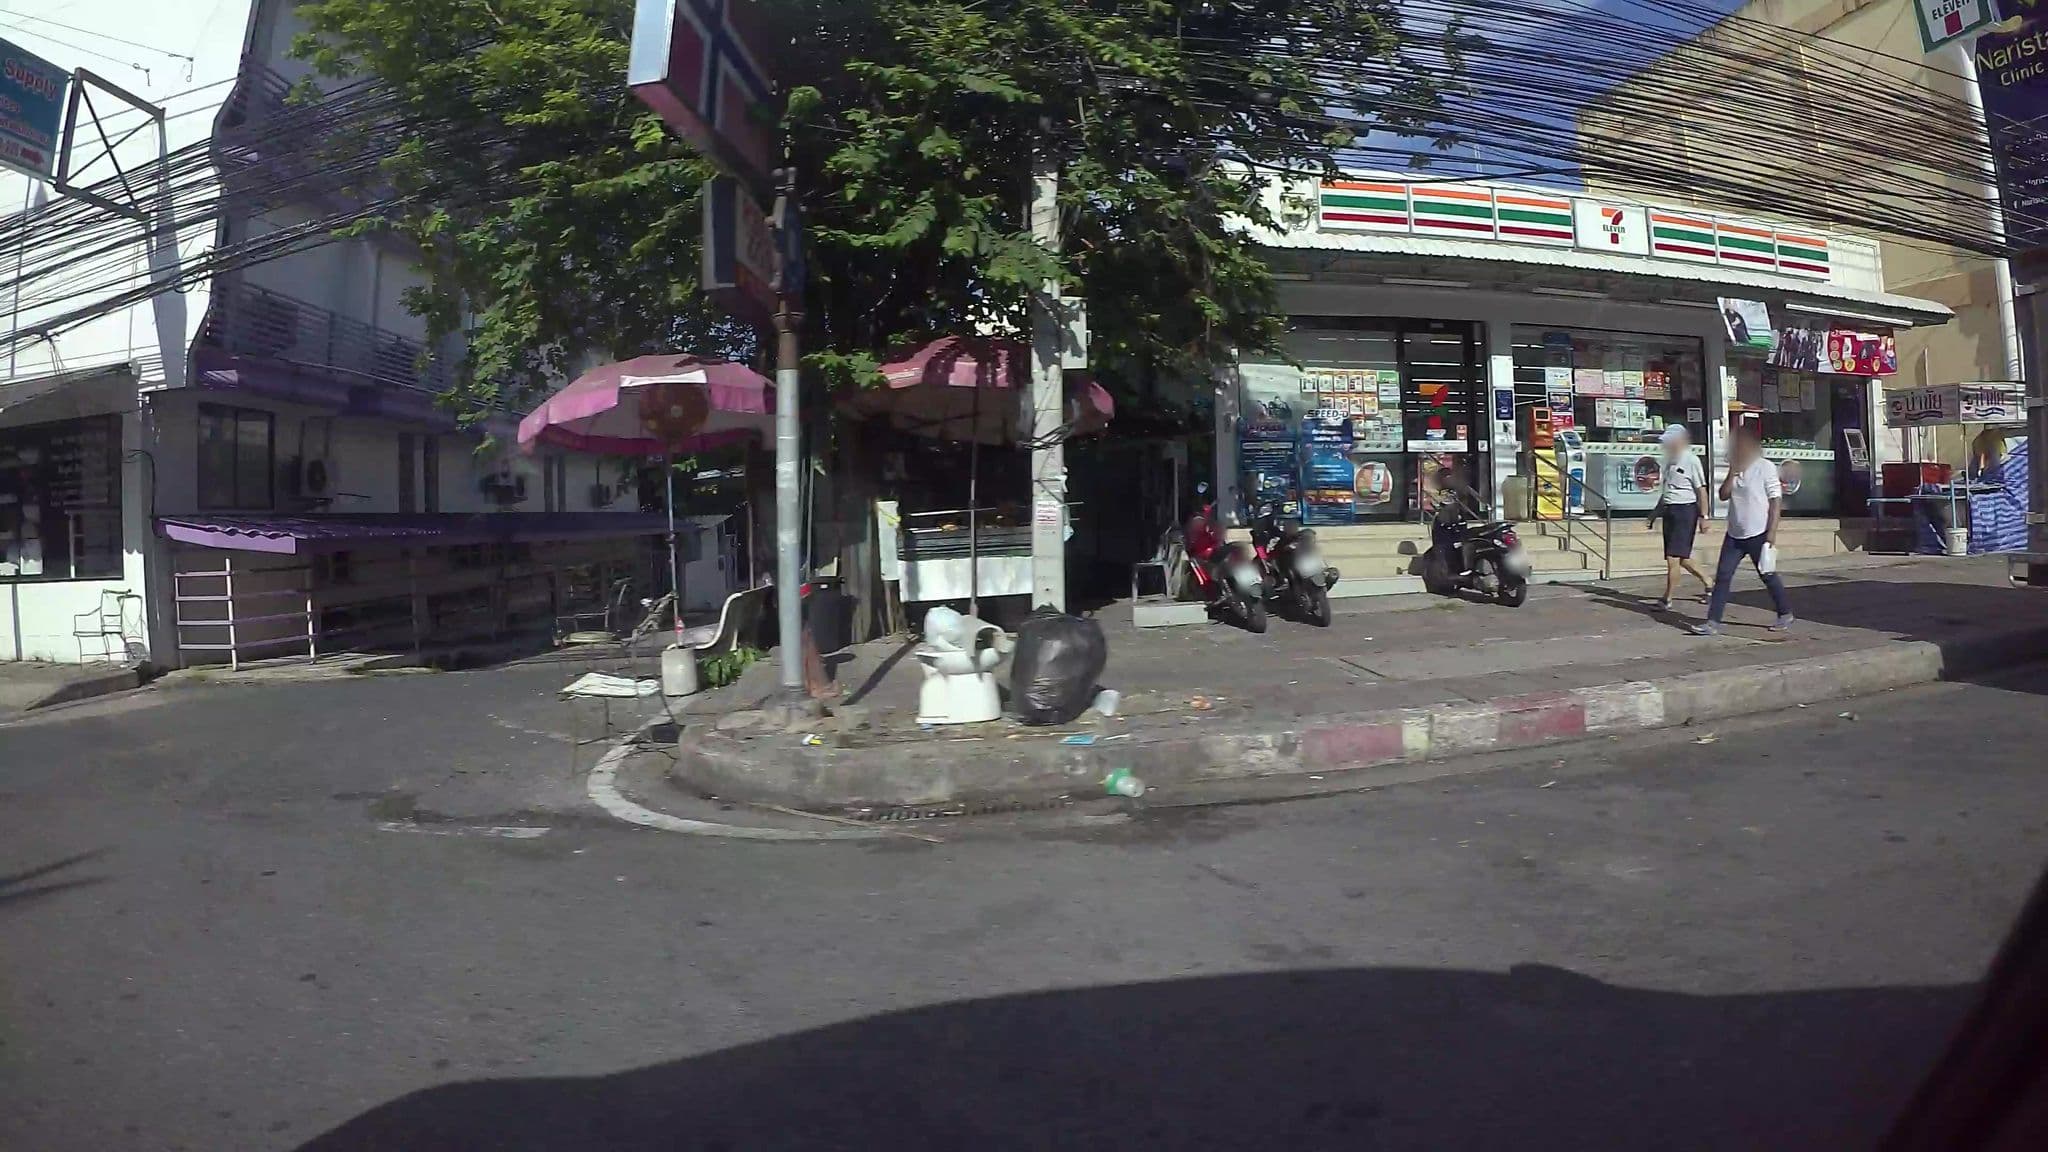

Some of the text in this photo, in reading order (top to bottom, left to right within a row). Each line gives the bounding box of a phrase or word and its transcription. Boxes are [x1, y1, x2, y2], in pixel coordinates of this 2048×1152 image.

[4, 57, 57, 101] Supply
[2000, 62, 2045, 86] Clinic
[1601, 207, 1624, 245] 7
[1307, 409, 1349, 418] SPEED-D
